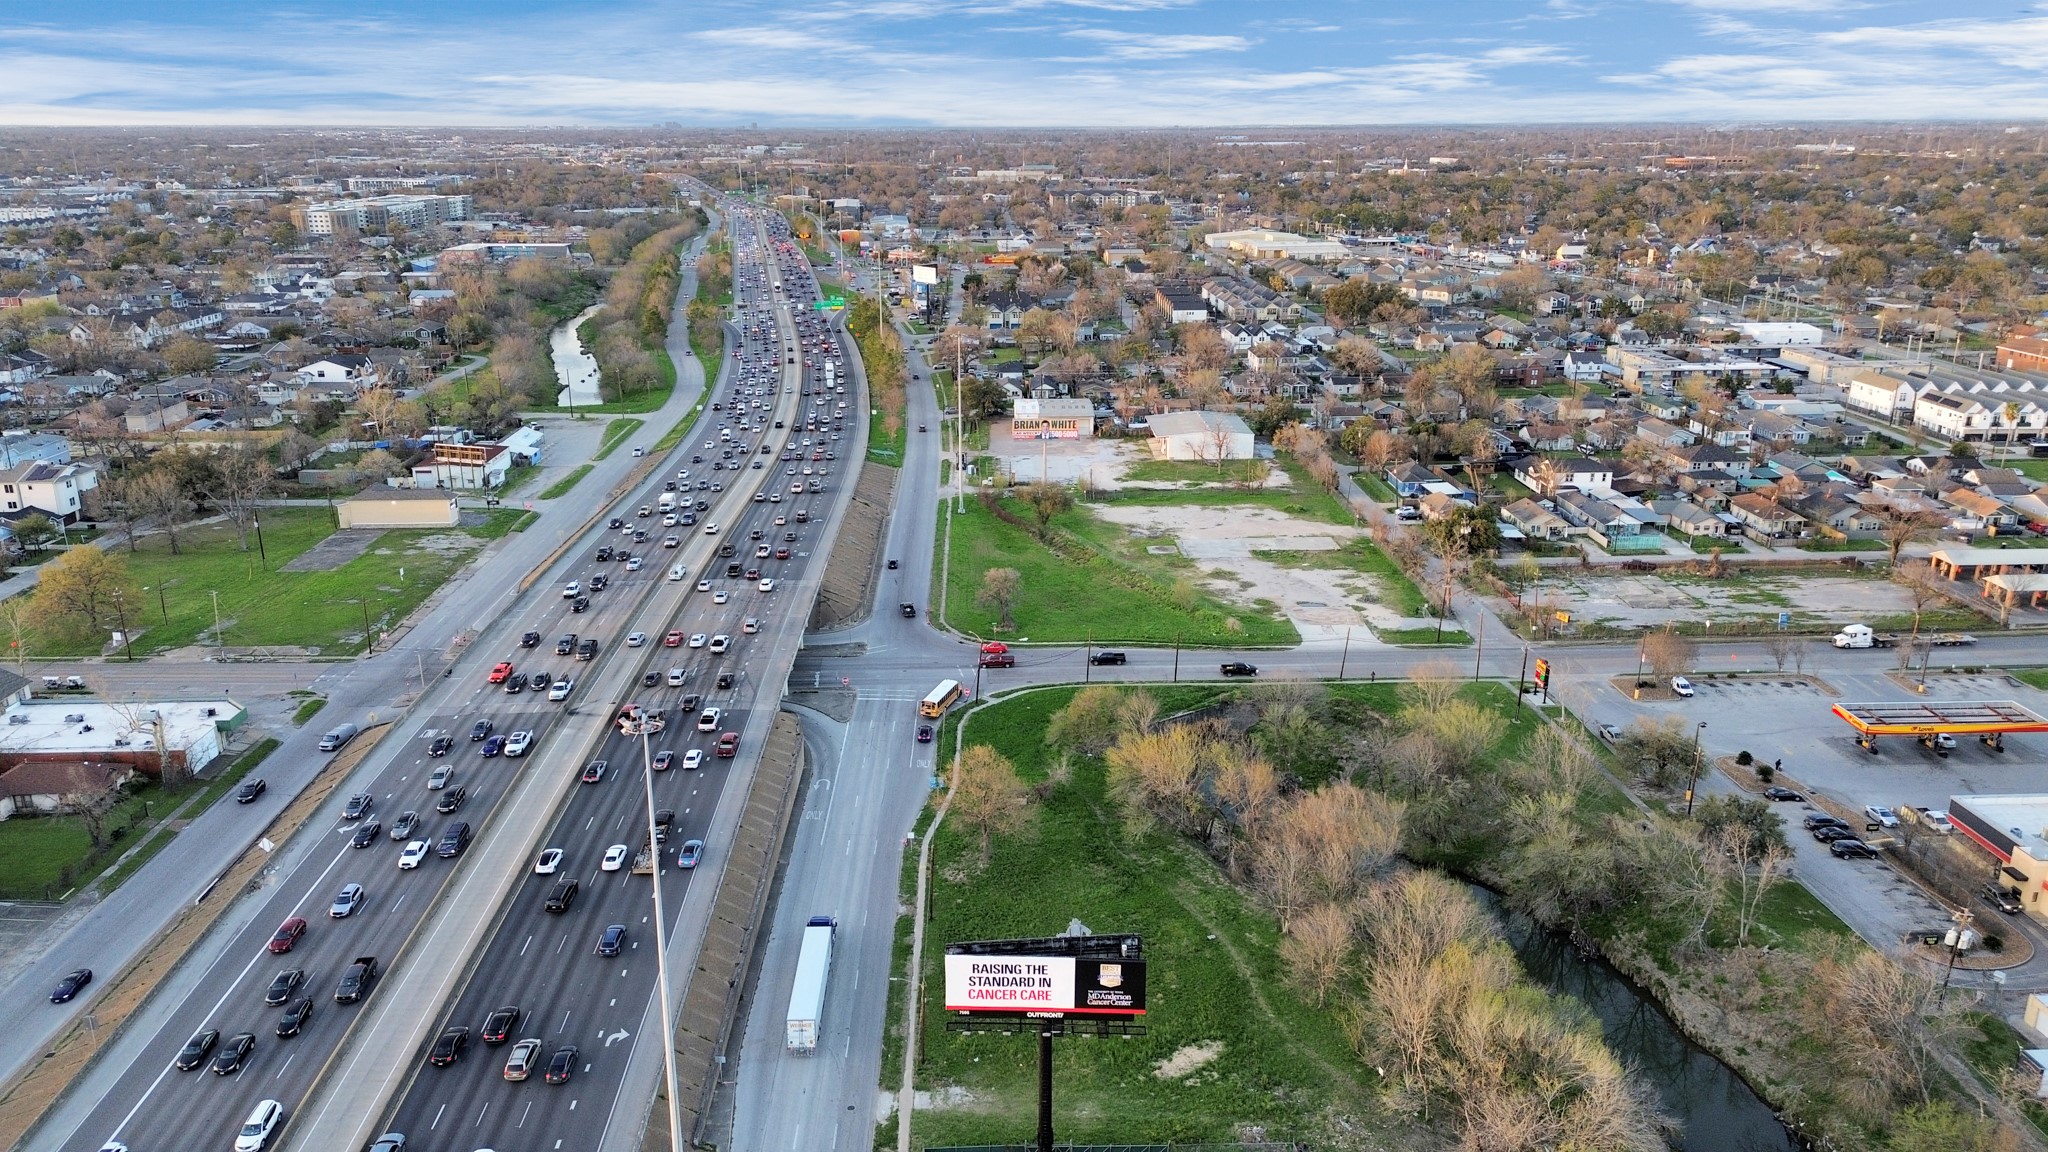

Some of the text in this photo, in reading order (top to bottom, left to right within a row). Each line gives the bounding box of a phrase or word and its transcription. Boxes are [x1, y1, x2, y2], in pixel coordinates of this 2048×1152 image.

[1014, 420, 1077, 429] BRIAN WHITE
[916, 759, 931, 769] ONLY
[805, 811, 824, 820] ONLY
[972, 963, 1048, 975] RAISING THE
[968, 976, 1052, 988] STANDARD IN
[968, 989, 1052, 1001] CANCER CARE
